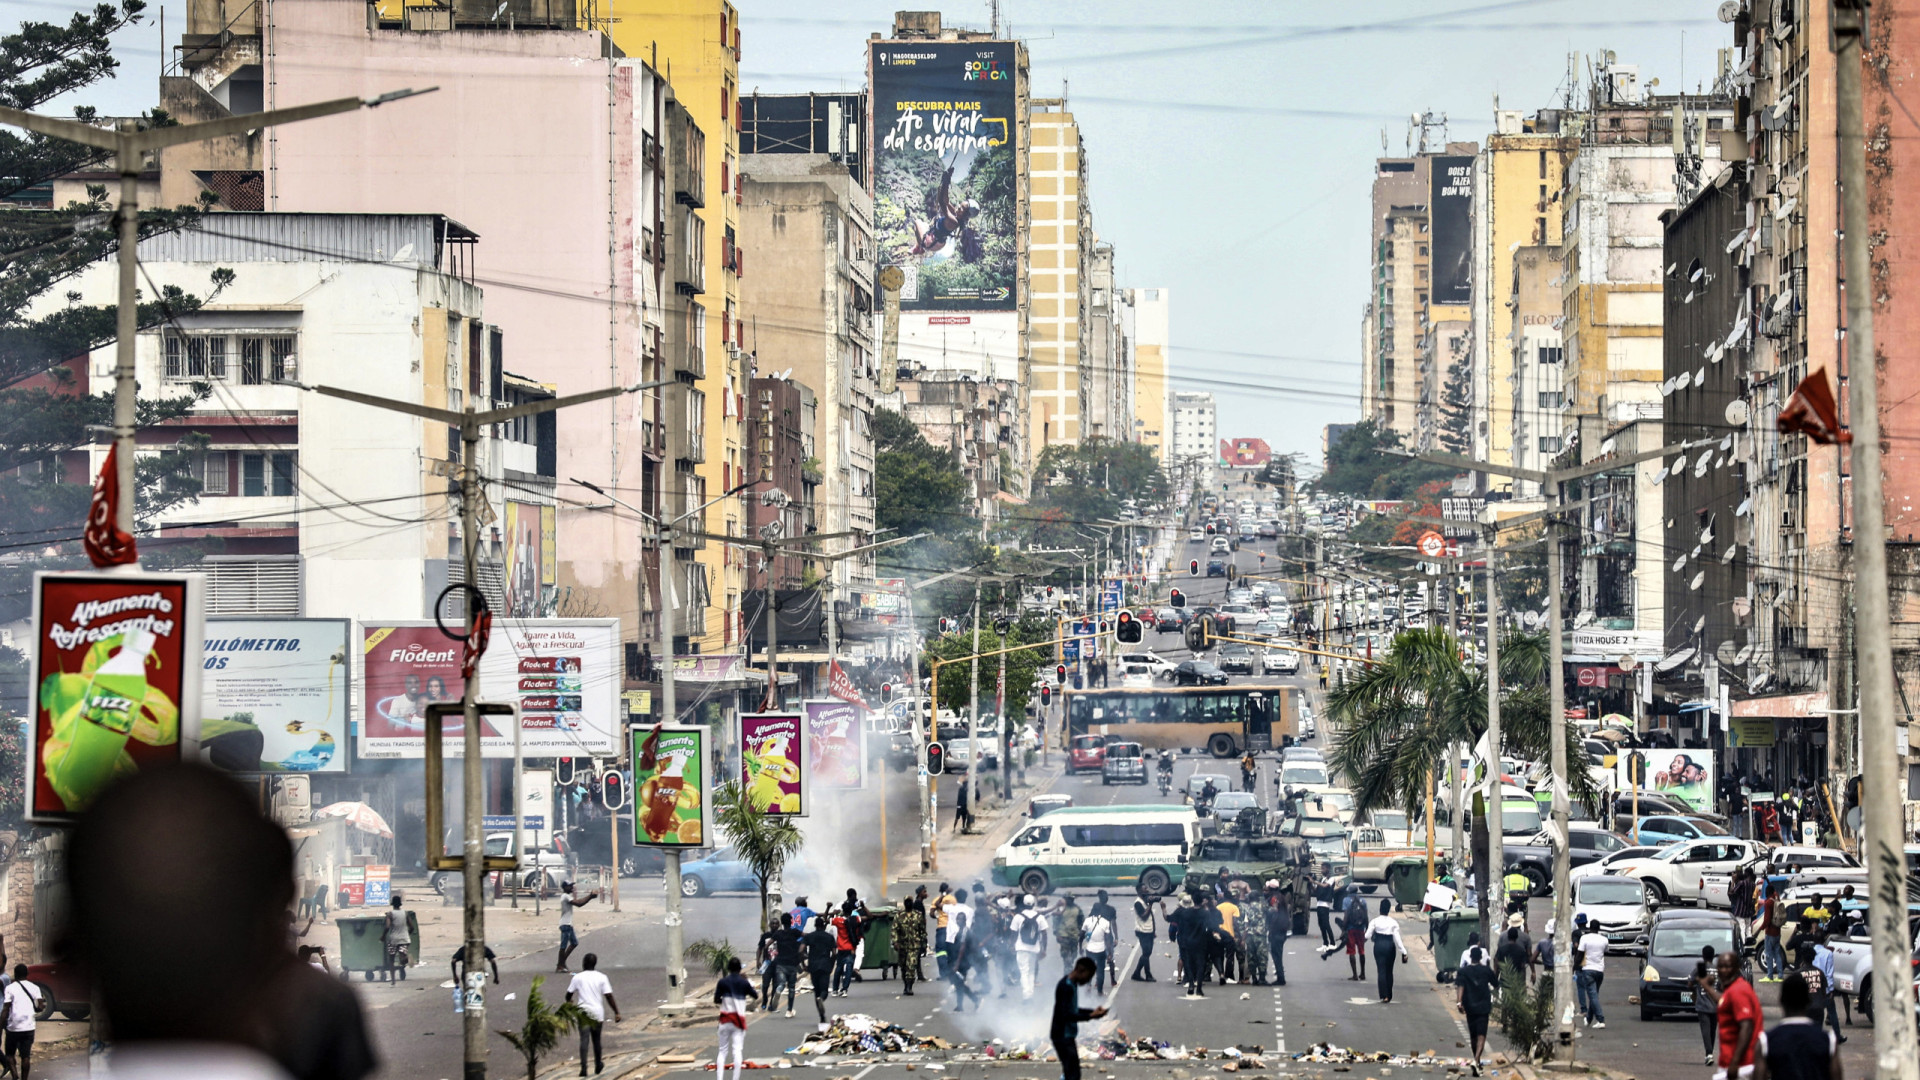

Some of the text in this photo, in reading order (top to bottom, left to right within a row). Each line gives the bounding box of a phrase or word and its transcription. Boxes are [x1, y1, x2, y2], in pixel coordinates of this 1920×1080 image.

[964, 61, 1008, 71] SOUTH
[964, 71, 1008, 81] AFRICA
[896, 102, 981, 111] DESCUBRA MAIS
[896, 107, 983, 142] Ao virar
[884, 128, 987, 158] da esquina
[1448, 166, 1465, 176] DOIS
[1442, 186, 1458, 196] BOM
[71, 592, 172, 626] Altamente
[50, 614, 174, 650] Refrescante!
[203, 636, 301, 651] UILÓMETRO,
[1579, 636, 1628, 644] PIZZA HOUSE 2
[390, 649, 455, 662] Flodent
[204, 655, 229, 670] ÓS
[830, 680, 858, 700] FRELIMO
[91, 695, 133, 711] FIZZ
[818, 706, 855, 720] Altamente
[755, 720, 795, 735] Altamente
[810, 715, 855, 728] Refrescante!
[659, 736, 694, 748] amente
[746, 732, 795, 744] Refrescante!
[657, 787, 677, 796] FIZZ
